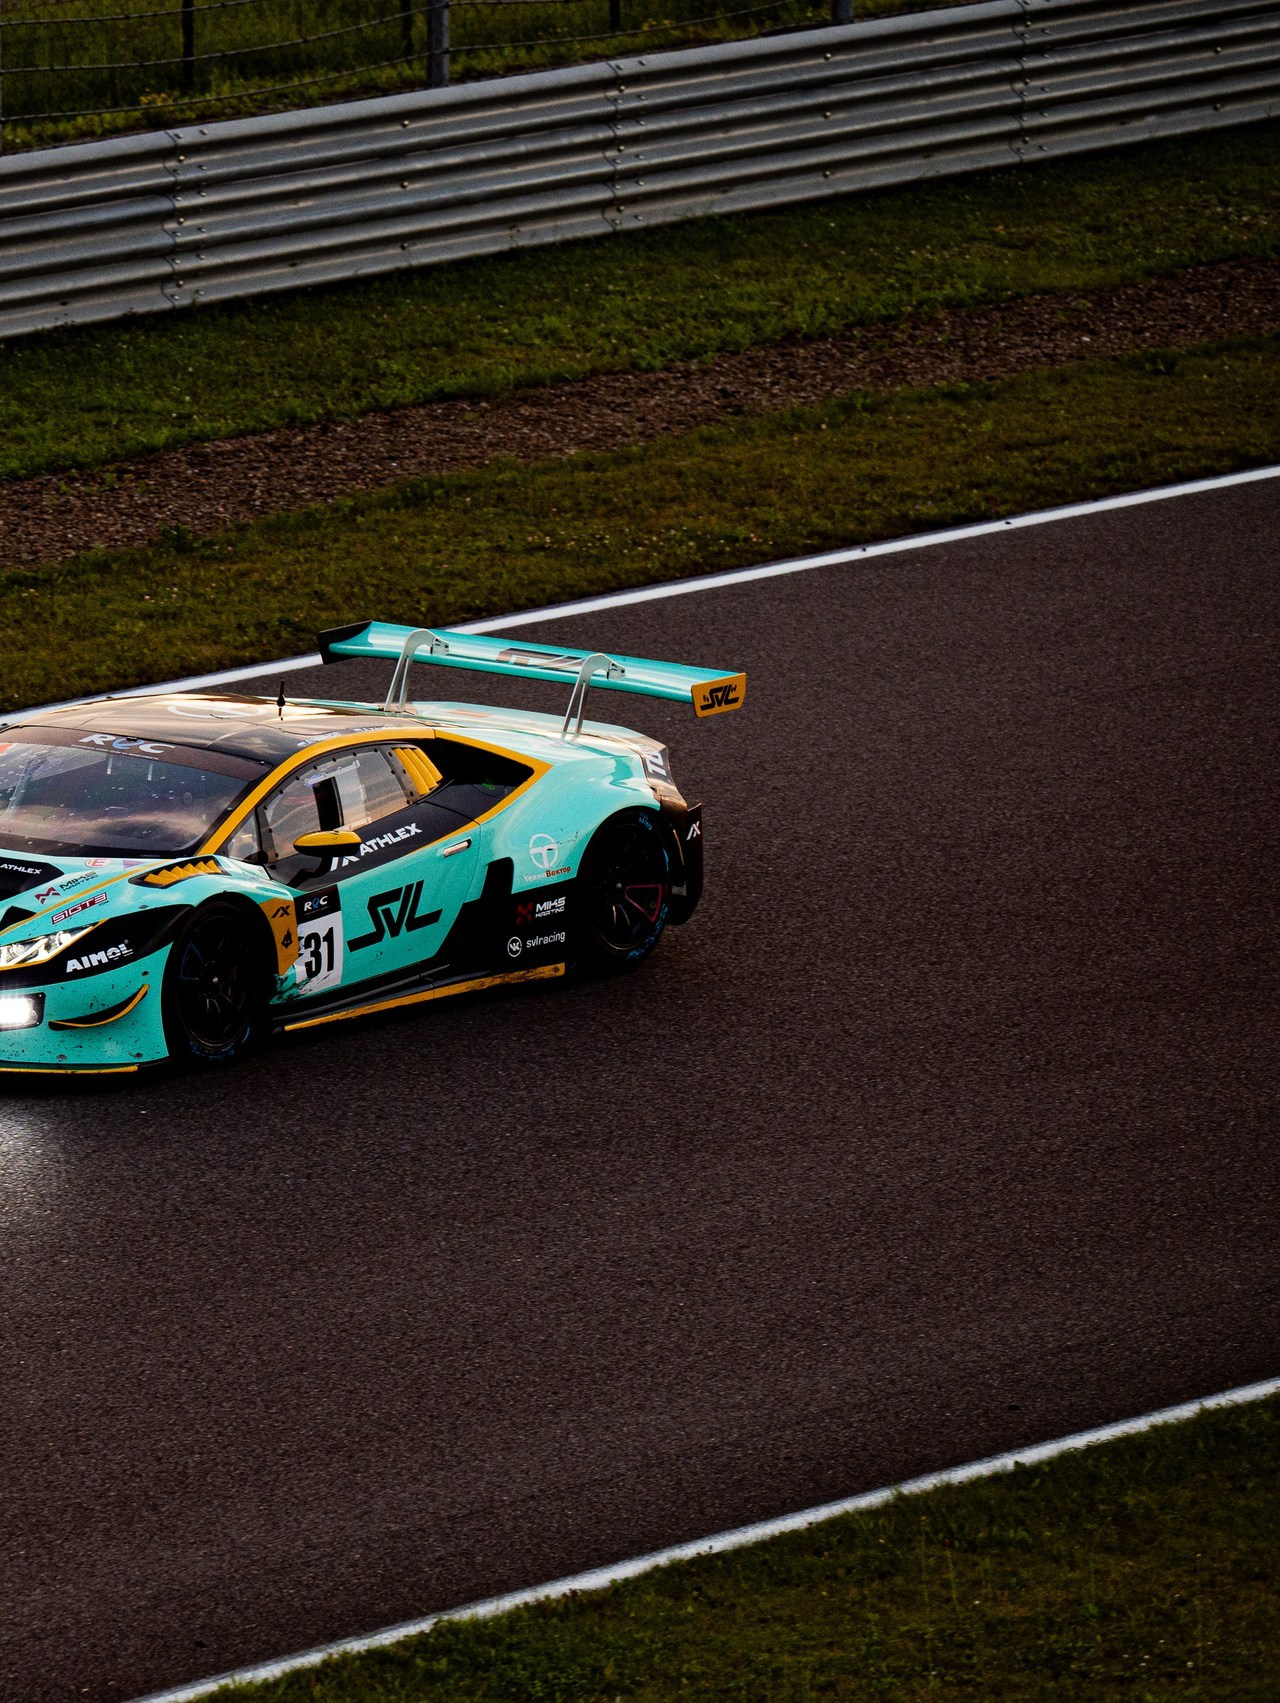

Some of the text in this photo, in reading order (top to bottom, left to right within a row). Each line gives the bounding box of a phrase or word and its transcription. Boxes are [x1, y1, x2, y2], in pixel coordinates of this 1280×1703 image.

[359, 823, 422, 856] ATHLEX
[0, 863, 42, 875] ATHLEX
[346, 880, 443, 953] SVL
[535, 897, 566, 912] MIKS
[526, 931, 565, 948] svlracing
[304, 927, 334, 979] 31
